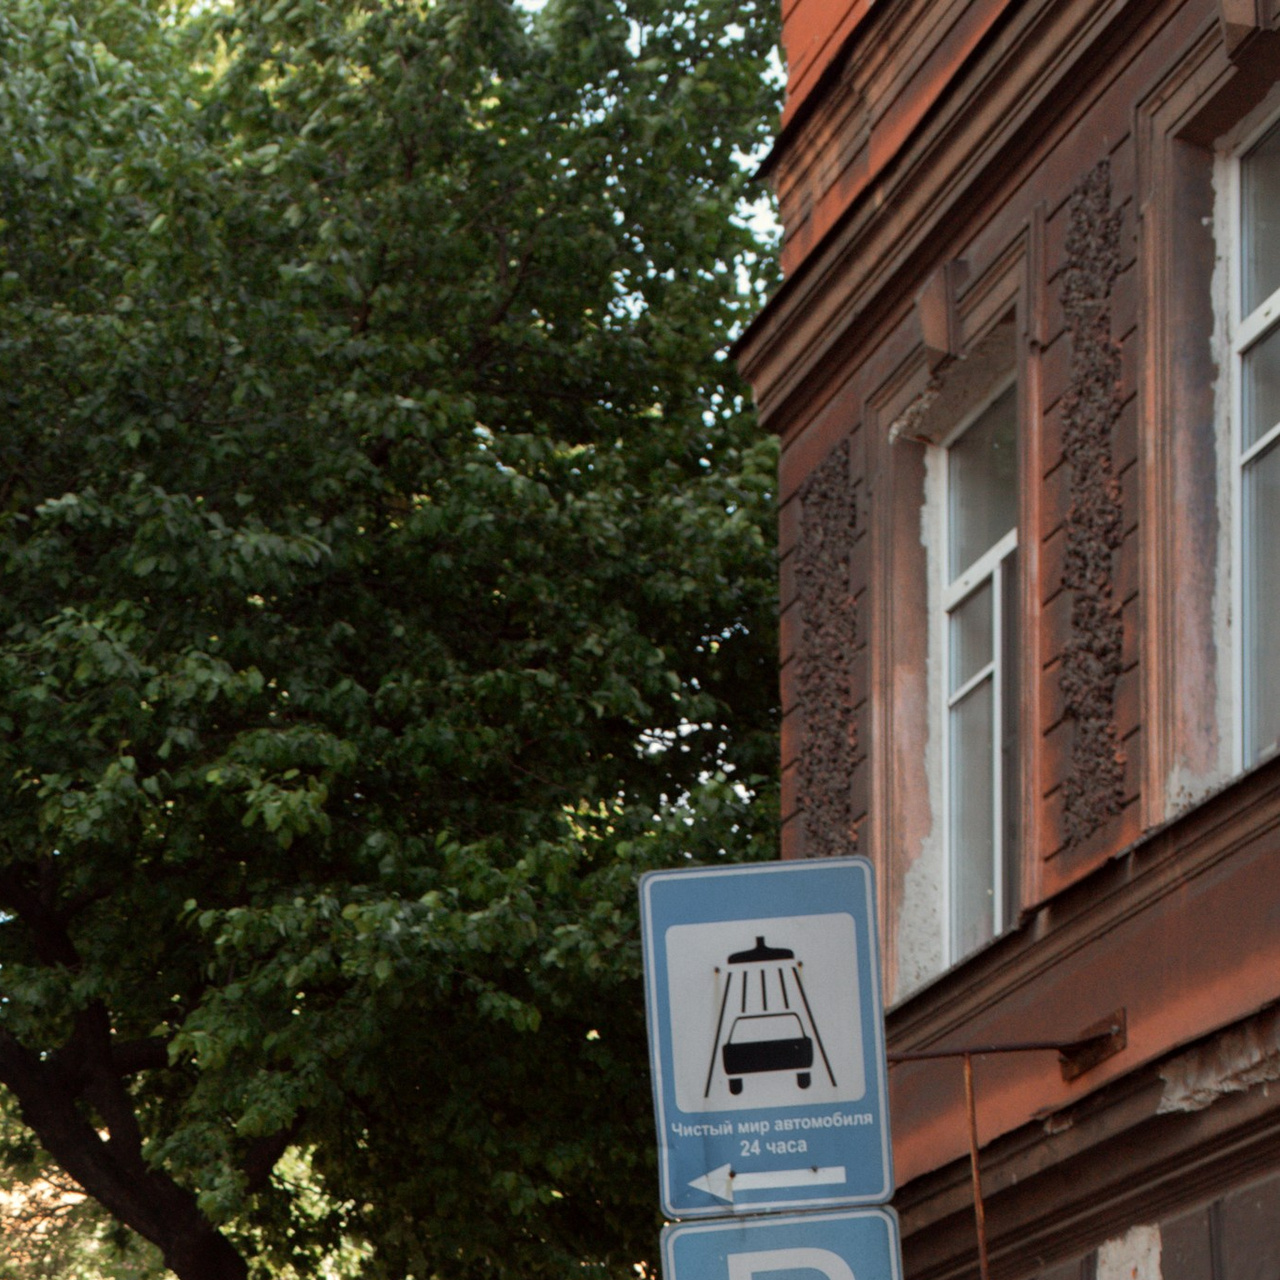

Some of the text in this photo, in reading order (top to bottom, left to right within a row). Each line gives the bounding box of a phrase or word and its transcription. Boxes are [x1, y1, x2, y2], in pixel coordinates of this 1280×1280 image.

[671, 1112, 874, 1137] Чистый мир автомобиля
[740, 1138, 808, 1157] 24 часа
